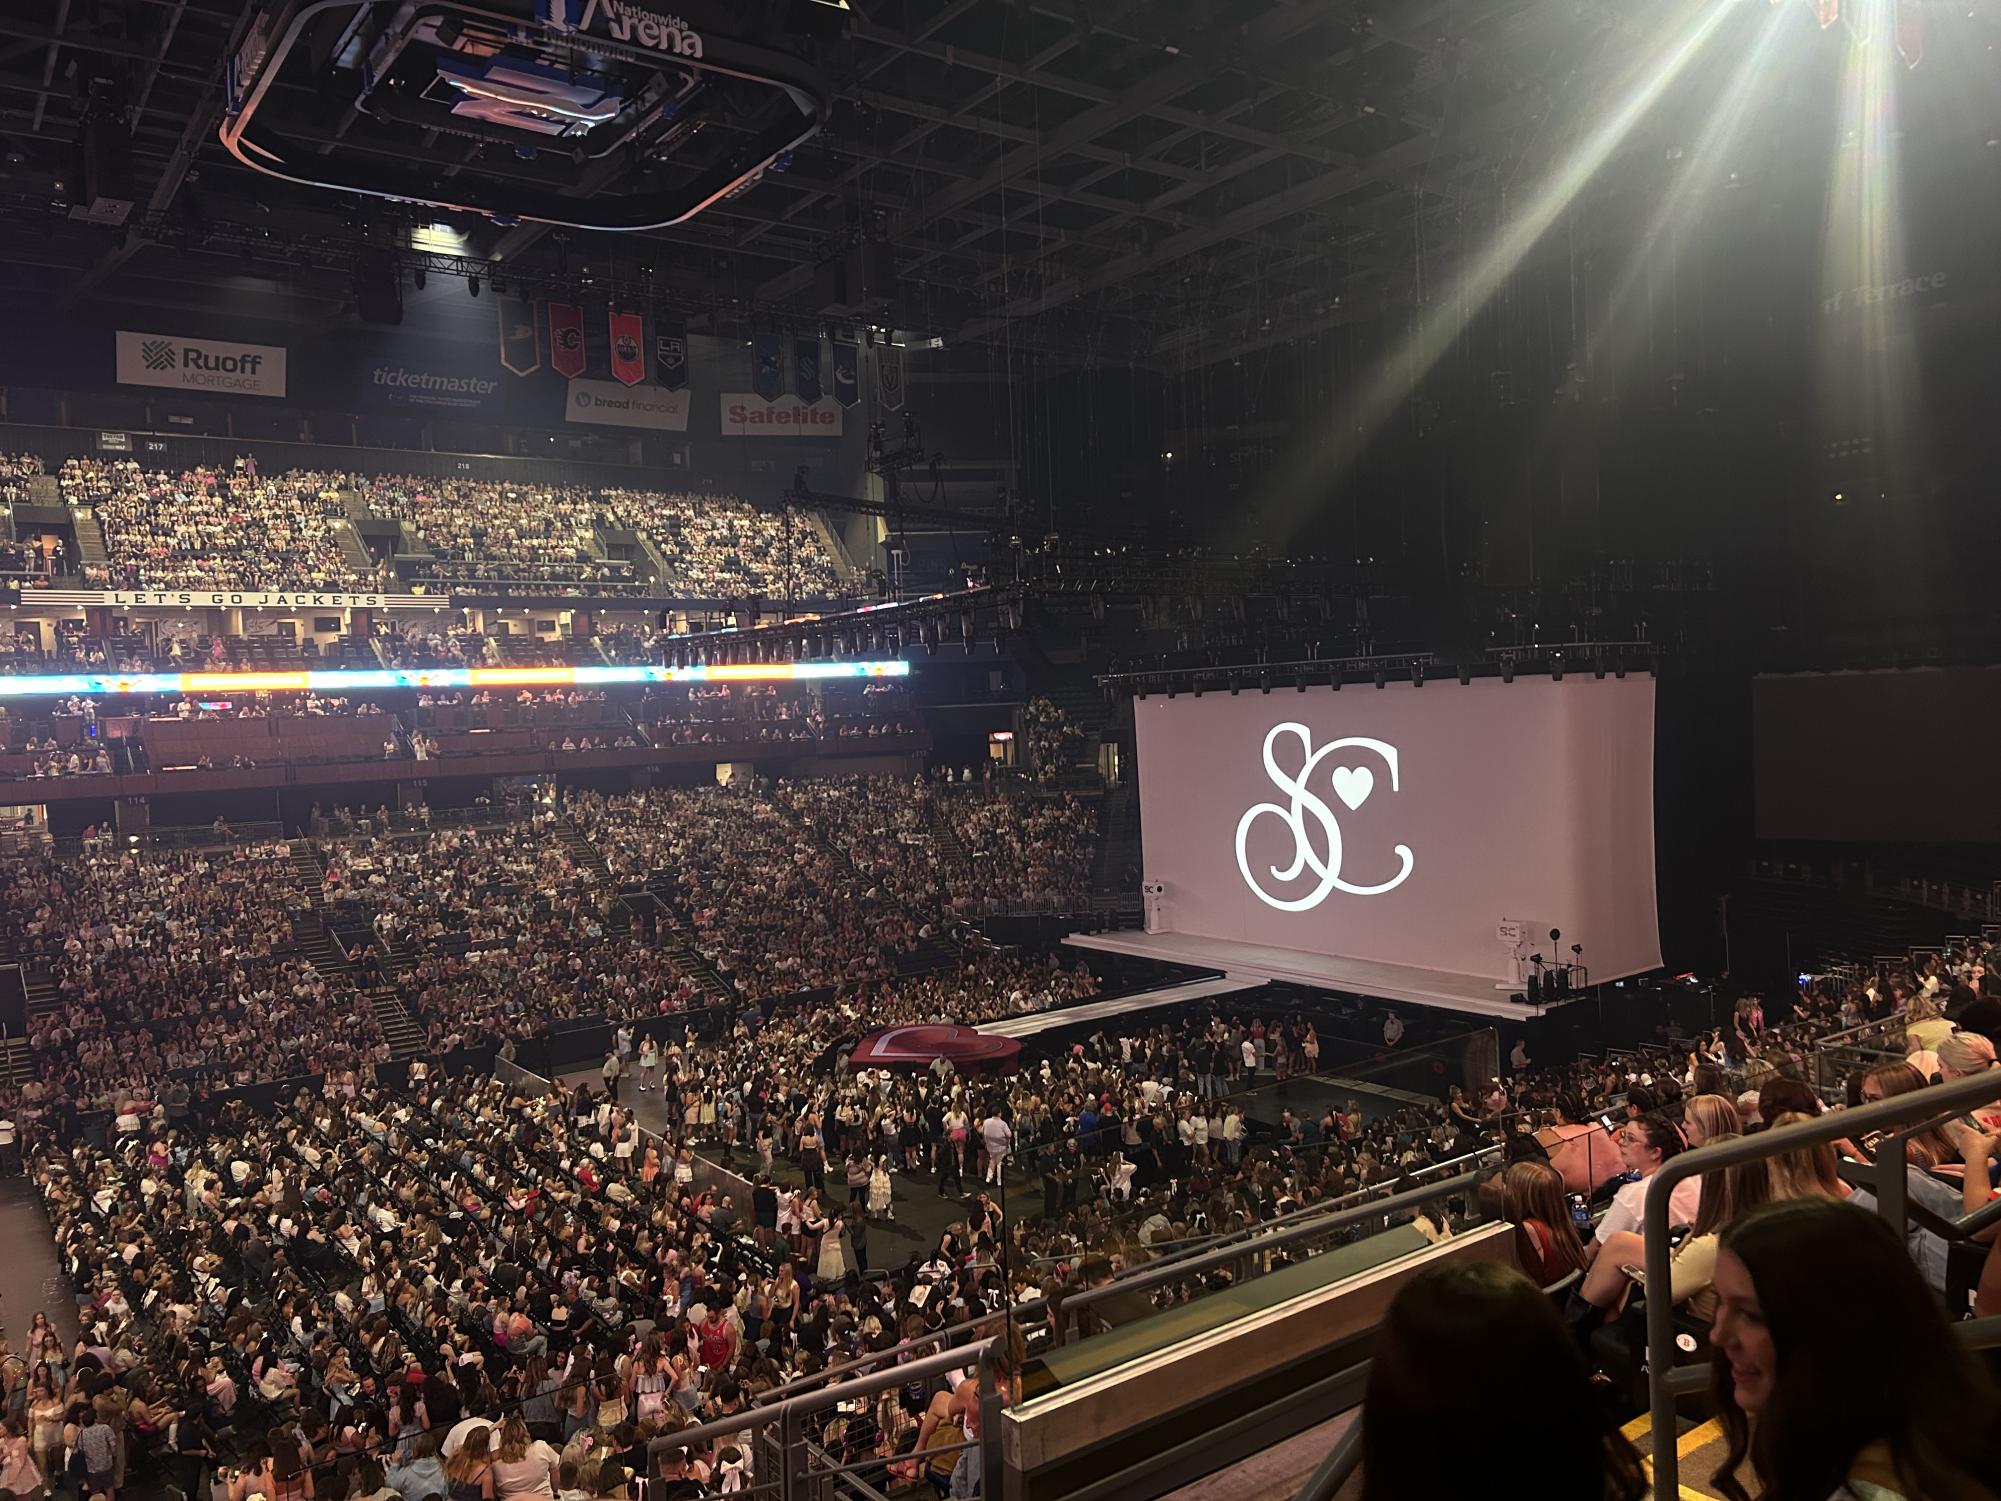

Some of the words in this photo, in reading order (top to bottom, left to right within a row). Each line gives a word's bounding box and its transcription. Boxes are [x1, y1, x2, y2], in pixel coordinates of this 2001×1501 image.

[613, 0, 689, 30] Nationwide
[183, 348, 262, 375] Ruoff
[182, 372, 261, 391] MORTGAGE
[373, 366, 498, 394] ticketmaster
[594, 395, 629, 409] bread
[631, 399, 679, 415] financial
[729, 405, 835, 425] Safelite
[148, 442, 164, 451] 217
[115, 593, 191, 604] LET'S
[211, 594, 243, 604] GO
[259, 594, 377, 605] JACKETS
[127, 796, 146, 805] 114
